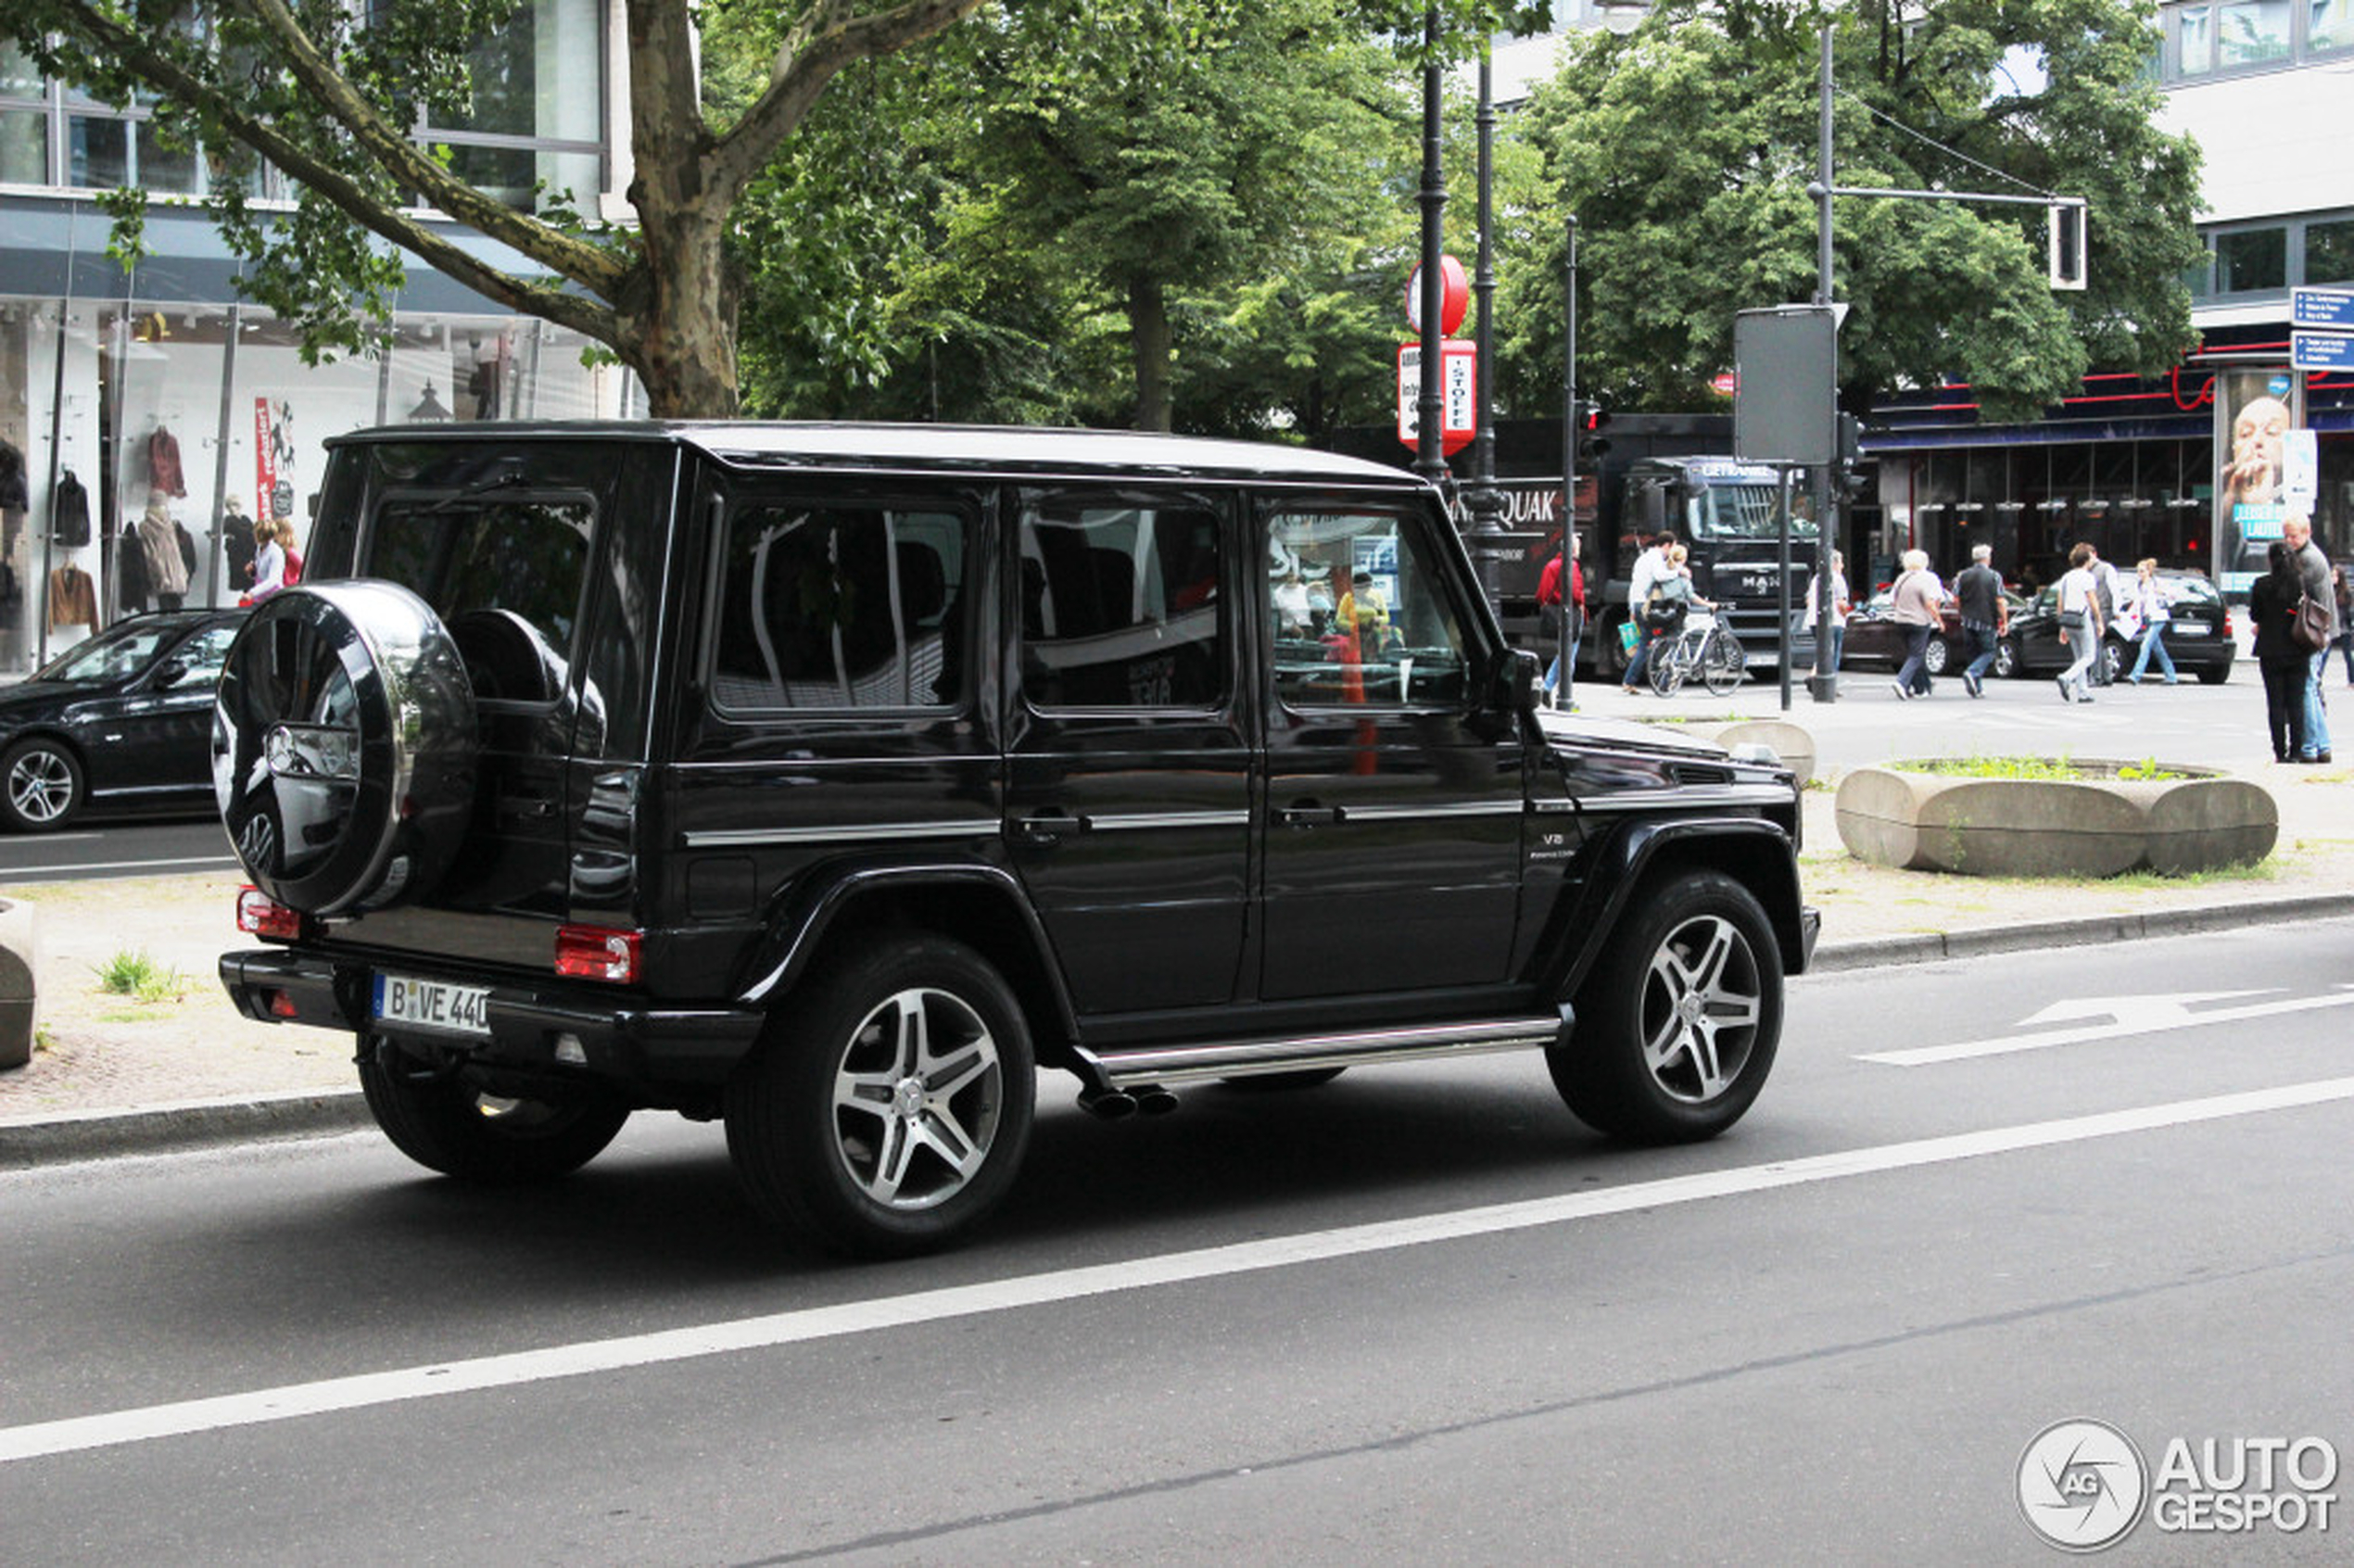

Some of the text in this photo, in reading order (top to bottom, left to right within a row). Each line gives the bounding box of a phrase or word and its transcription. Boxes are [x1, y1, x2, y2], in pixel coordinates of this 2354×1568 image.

[1451, 368, 1465, 428] STOFFE
[1741, 575, 1780, 588] MAN
[391, 980, 487, 1028] B VE 440
